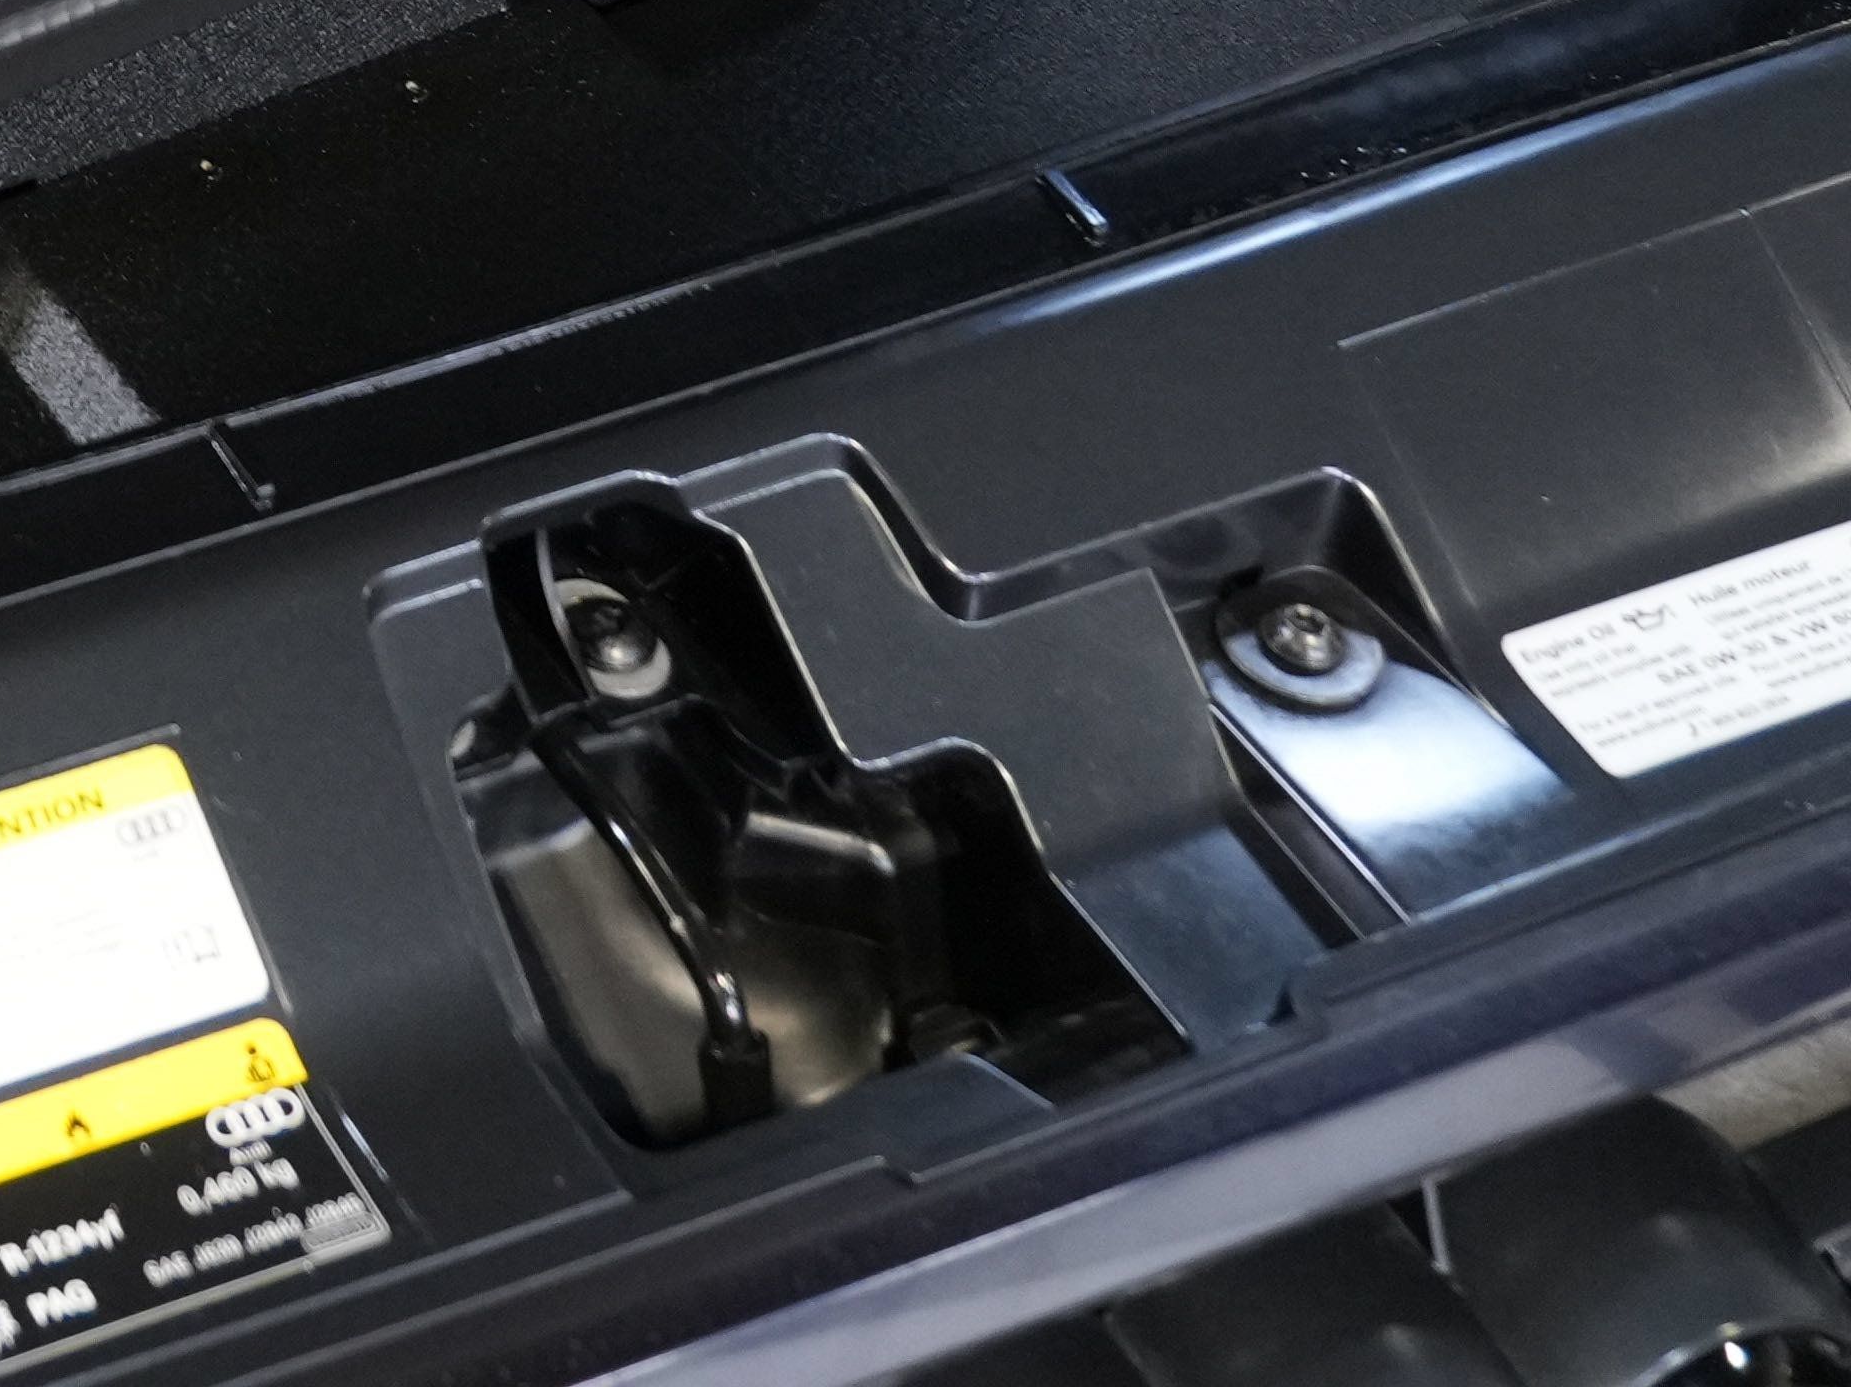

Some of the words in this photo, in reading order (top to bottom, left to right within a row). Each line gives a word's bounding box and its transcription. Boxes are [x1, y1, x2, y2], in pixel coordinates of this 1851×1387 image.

[1688, 584, 1739, 607] Huile
[1742, 561, 1811, 590] moteur
[1521, 637, 1585, 665] Engine
[1588, 624, 1617, 641] Oil
[1655, 661, 1698, 685] SAE
[1789, 619, 1829, 638] VW
[253, 1156, 299, 1192] kg
[26, 1278, 98, 1328] PAG
